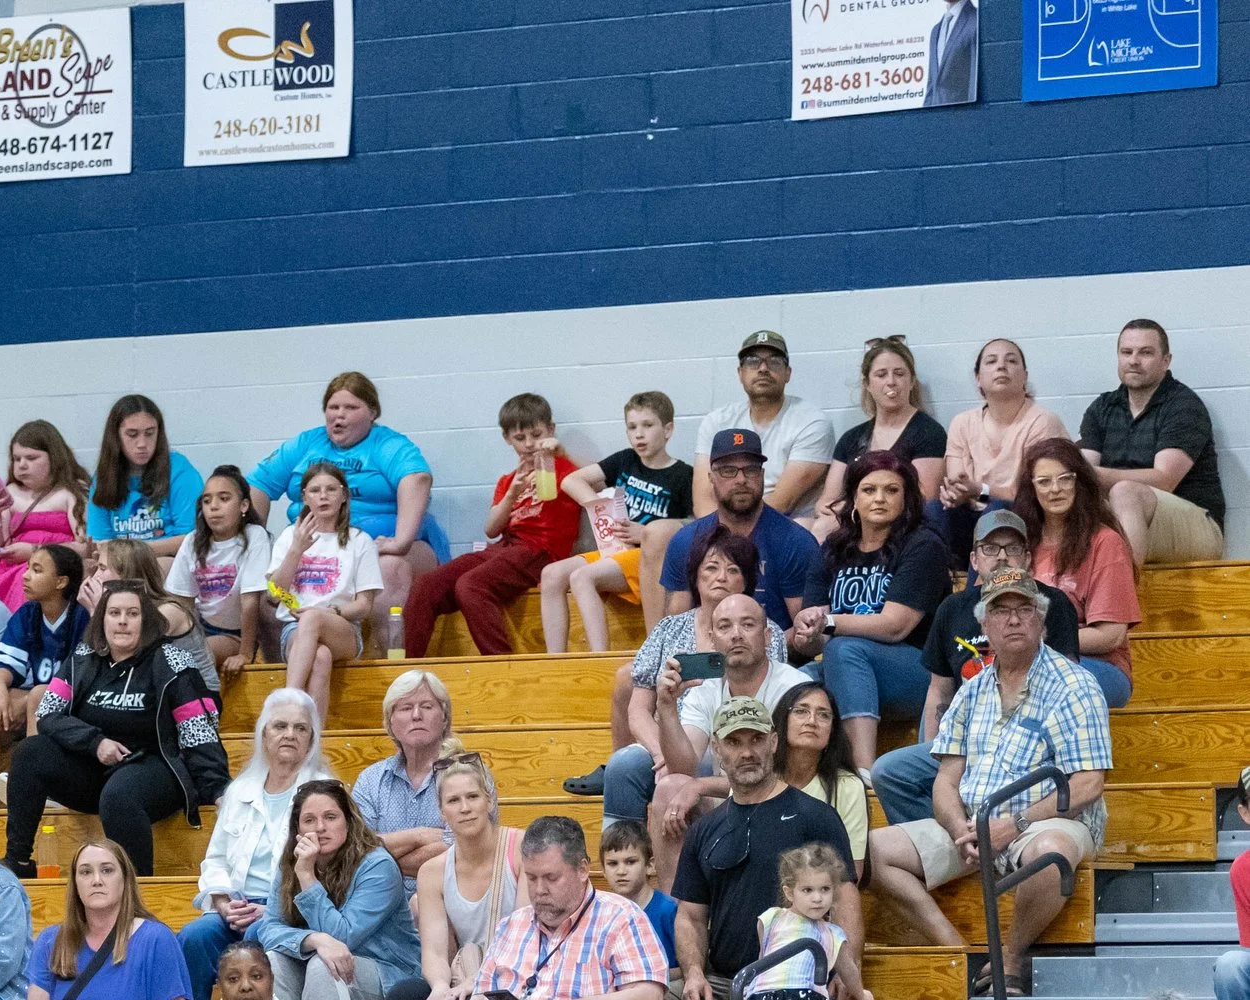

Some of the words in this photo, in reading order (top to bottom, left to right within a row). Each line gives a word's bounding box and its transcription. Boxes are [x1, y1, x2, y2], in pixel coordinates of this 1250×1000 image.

[840, 0, 887, 13] DENTAL
[839, 44, 853, 52] Lake
[1111, 38, 1131, 49] LAKE
[1111, 45, 1154, 57] MICHIGAN
[801, 51, 925, 70] www.summitdentalgroup.com
[801, 65, 924, 95] 248-681-3600
[816, 88, 924, 109] @summitdentalwaterford
[1, 104, 10, 120] &
[14, 101, 57, 123] Supply
[65, 99, 106, 117] Center
[214, 113, 321, 139] 248-620-3181
[198, 141, 335, 157] www.castlewoodcustomhomes.com
[627, 475, 663, 496] COOLEY
[829, 572, 893, 611] IONS
[726, 708, 759, 721] GLOCK
